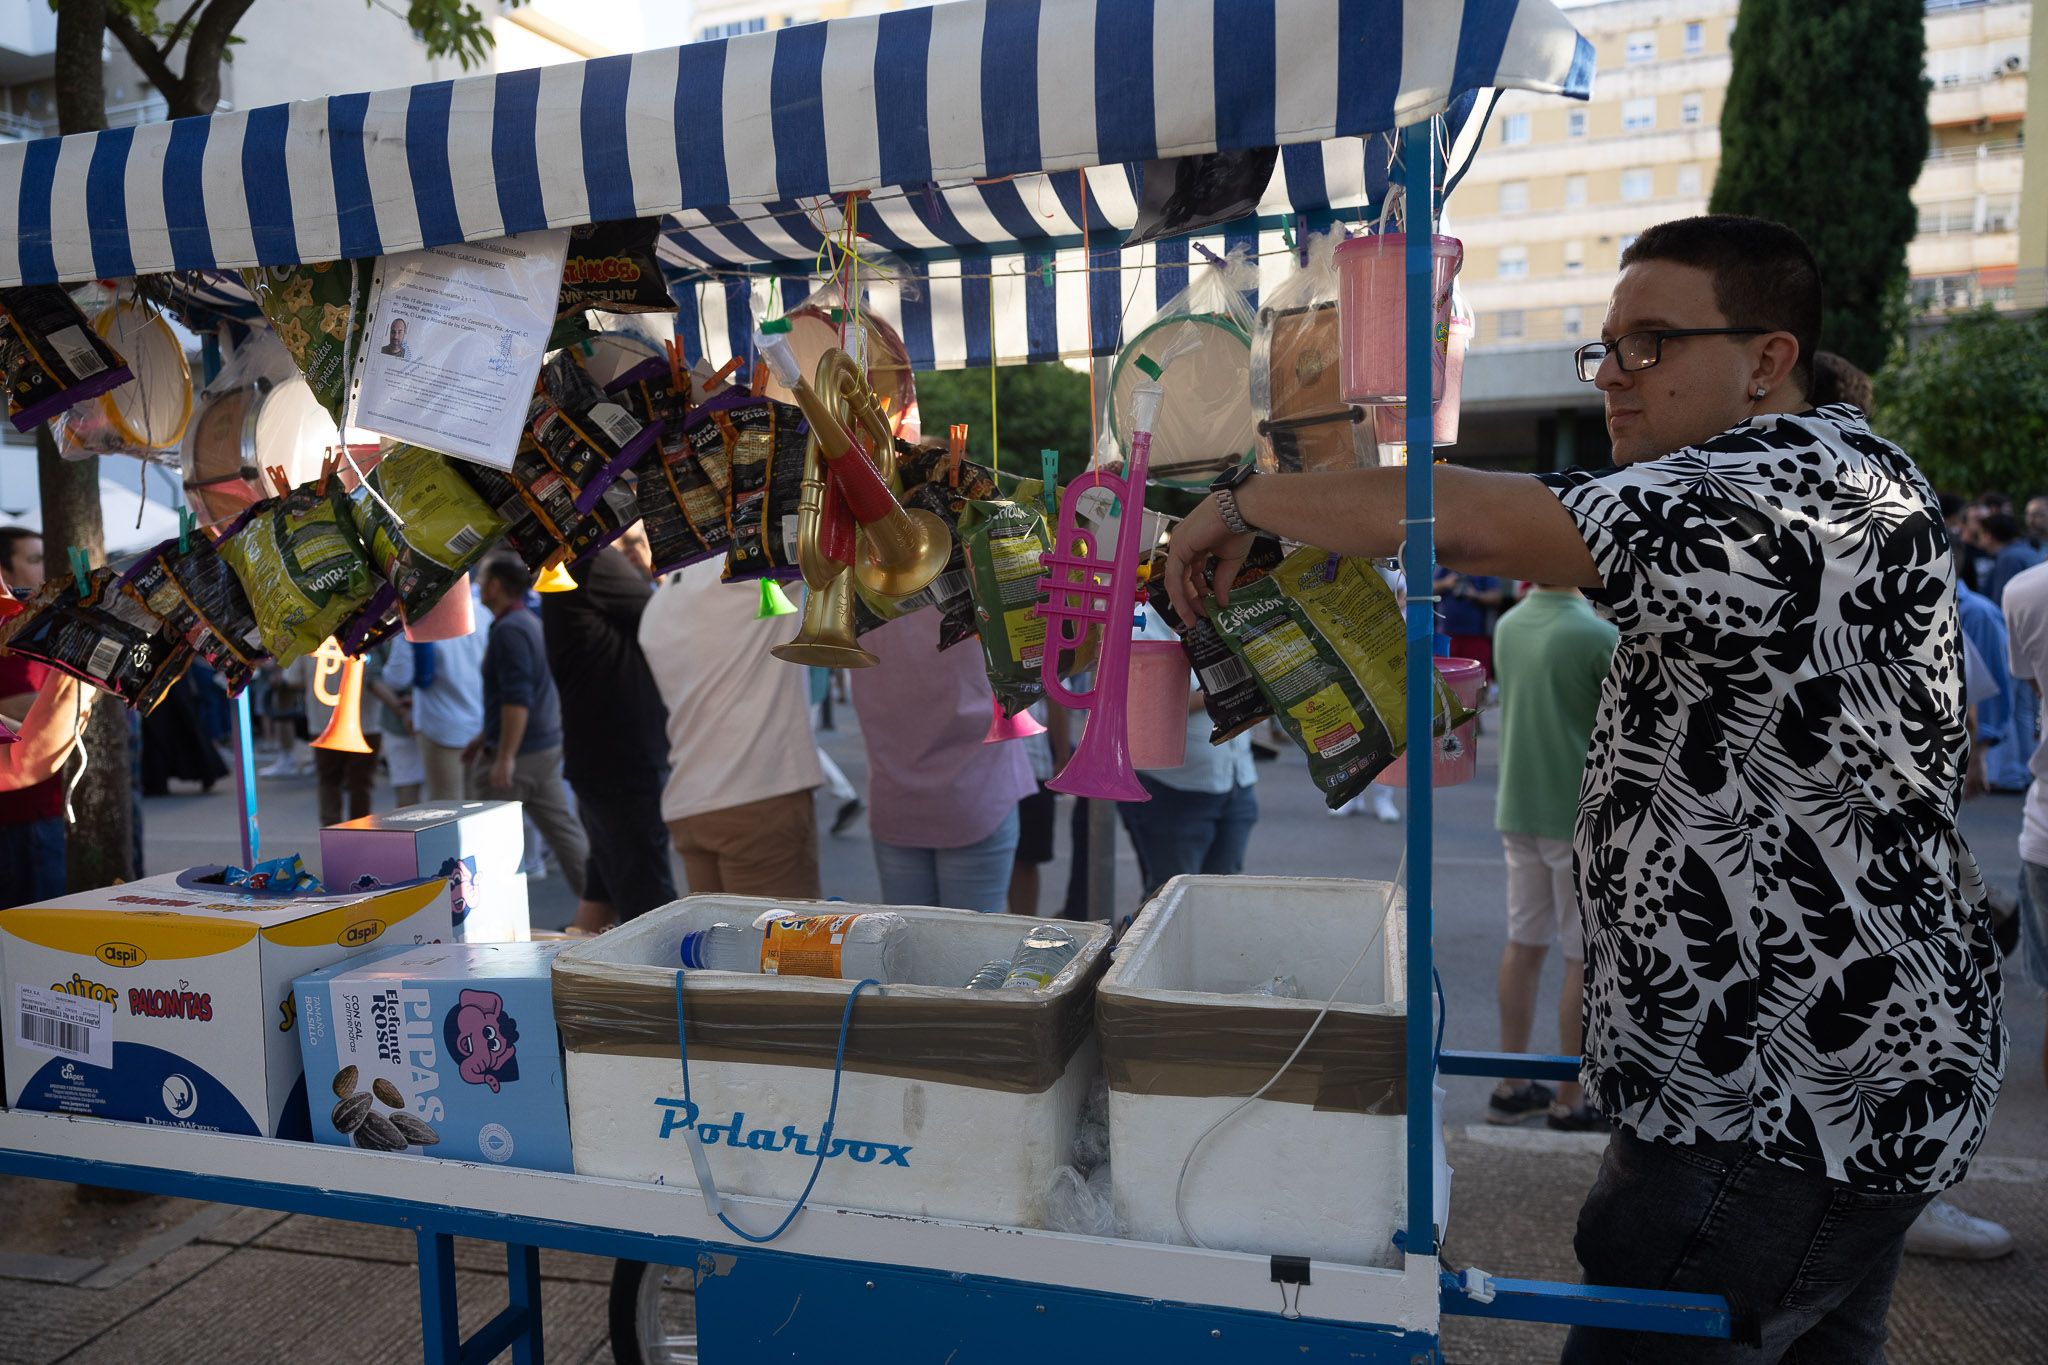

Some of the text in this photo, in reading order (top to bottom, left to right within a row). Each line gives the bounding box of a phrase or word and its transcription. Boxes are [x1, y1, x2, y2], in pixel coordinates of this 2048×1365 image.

[104, 947, 137, 964] aspil
[346, 923, 378, 942] aspil
[128, 985, 212, 1022] PALOMITAS
[304, 996, 318, 1046] BOLSILLO
[314, 995, 325, 1038] TAMAÑO
[352, 994, 364, 1040] CON SAL
[386, 989, 402, 1065] Elefante
[402, 984, 444, 1124] PIPAS
[654, 1096, 913, 1168] Polarbox
